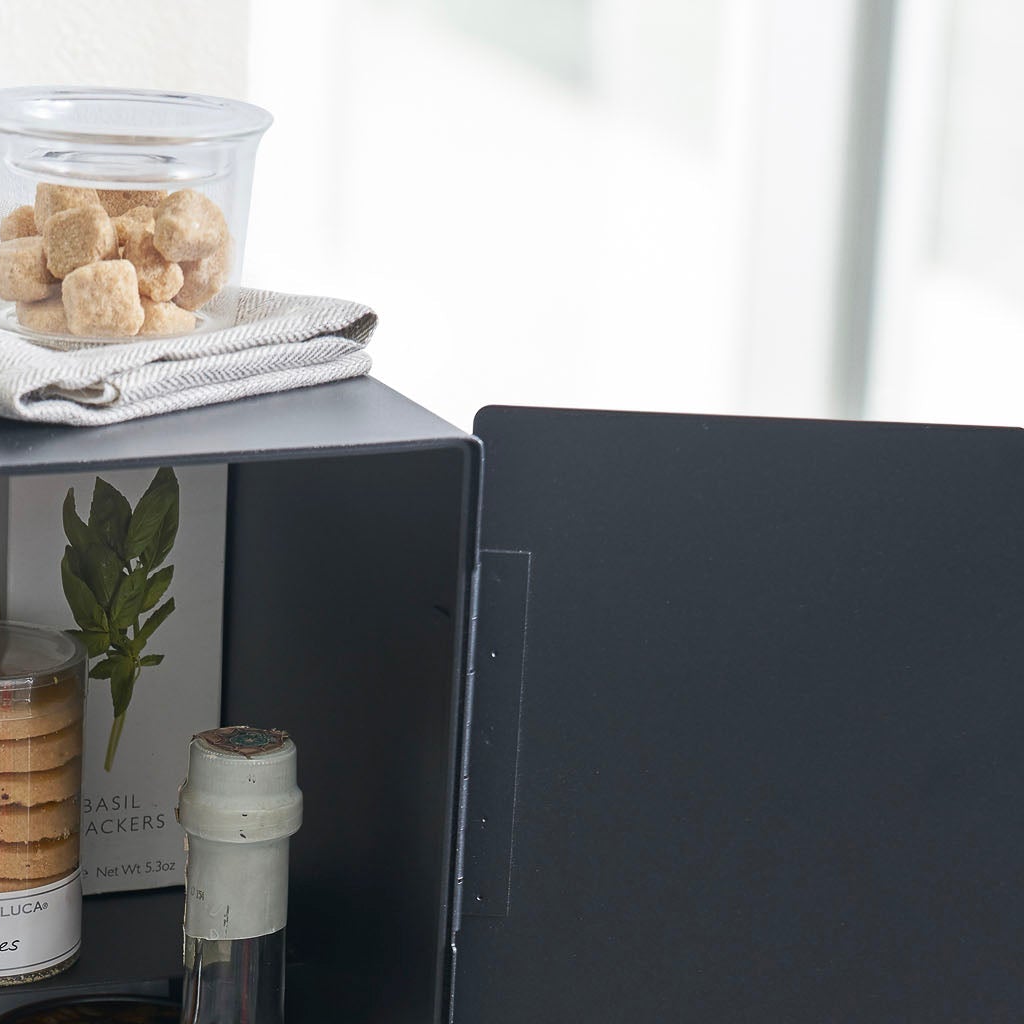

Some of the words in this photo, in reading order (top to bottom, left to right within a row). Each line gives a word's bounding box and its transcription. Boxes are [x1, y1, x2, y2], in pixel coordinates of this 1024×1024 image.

[83, 794, 141, 814] BASIL
[84, 814, 165, 837] ACKERS
[96, 867, 118, 878] Net
[121, 864, 141, 875] Wt
[145, 861, 176, 874] 5.3oz
